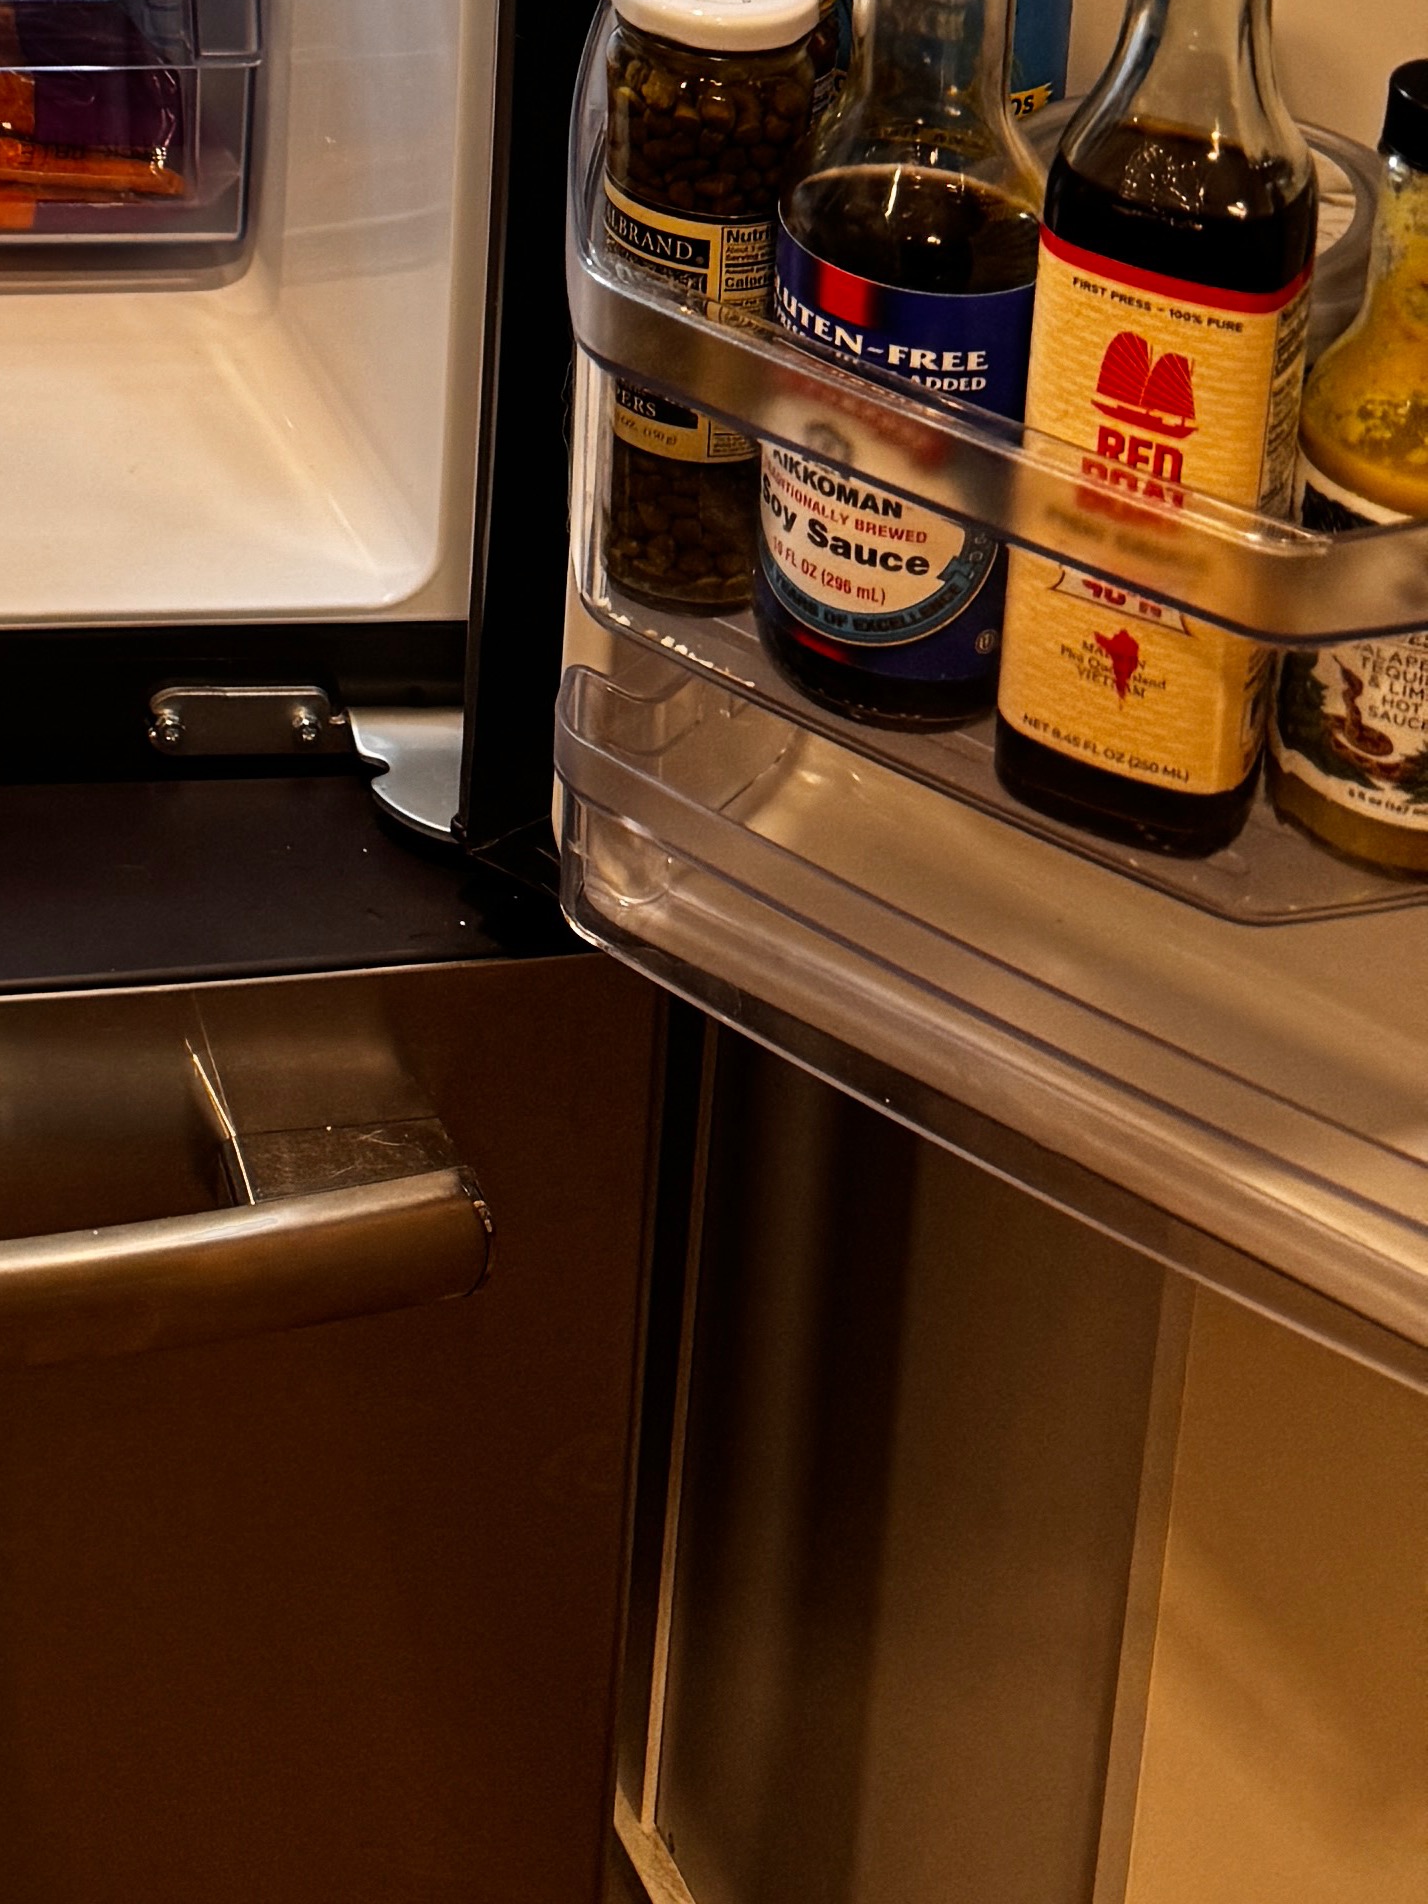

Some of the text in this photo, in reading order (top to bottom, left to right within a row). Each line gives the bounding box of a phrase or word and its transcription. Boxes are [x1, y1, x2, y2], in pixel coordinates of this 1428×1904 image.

[1072, 276, 1244, 334] FIRST PRESS 100% PURE
[1097, 425, 1183, 484] RED
[762, 473, 930, 576] Soy Sauce
[854, 518, 927, 544] BREWED
[785, 548, 886, 606] FL OZ (296 mL)
[1076, 665, 1147, 699] VIETAM
[1382, 695, 1420, 714] HOT
[1022, 712, 1189, 783] NET 8.45 FL OZ (250 ML)
